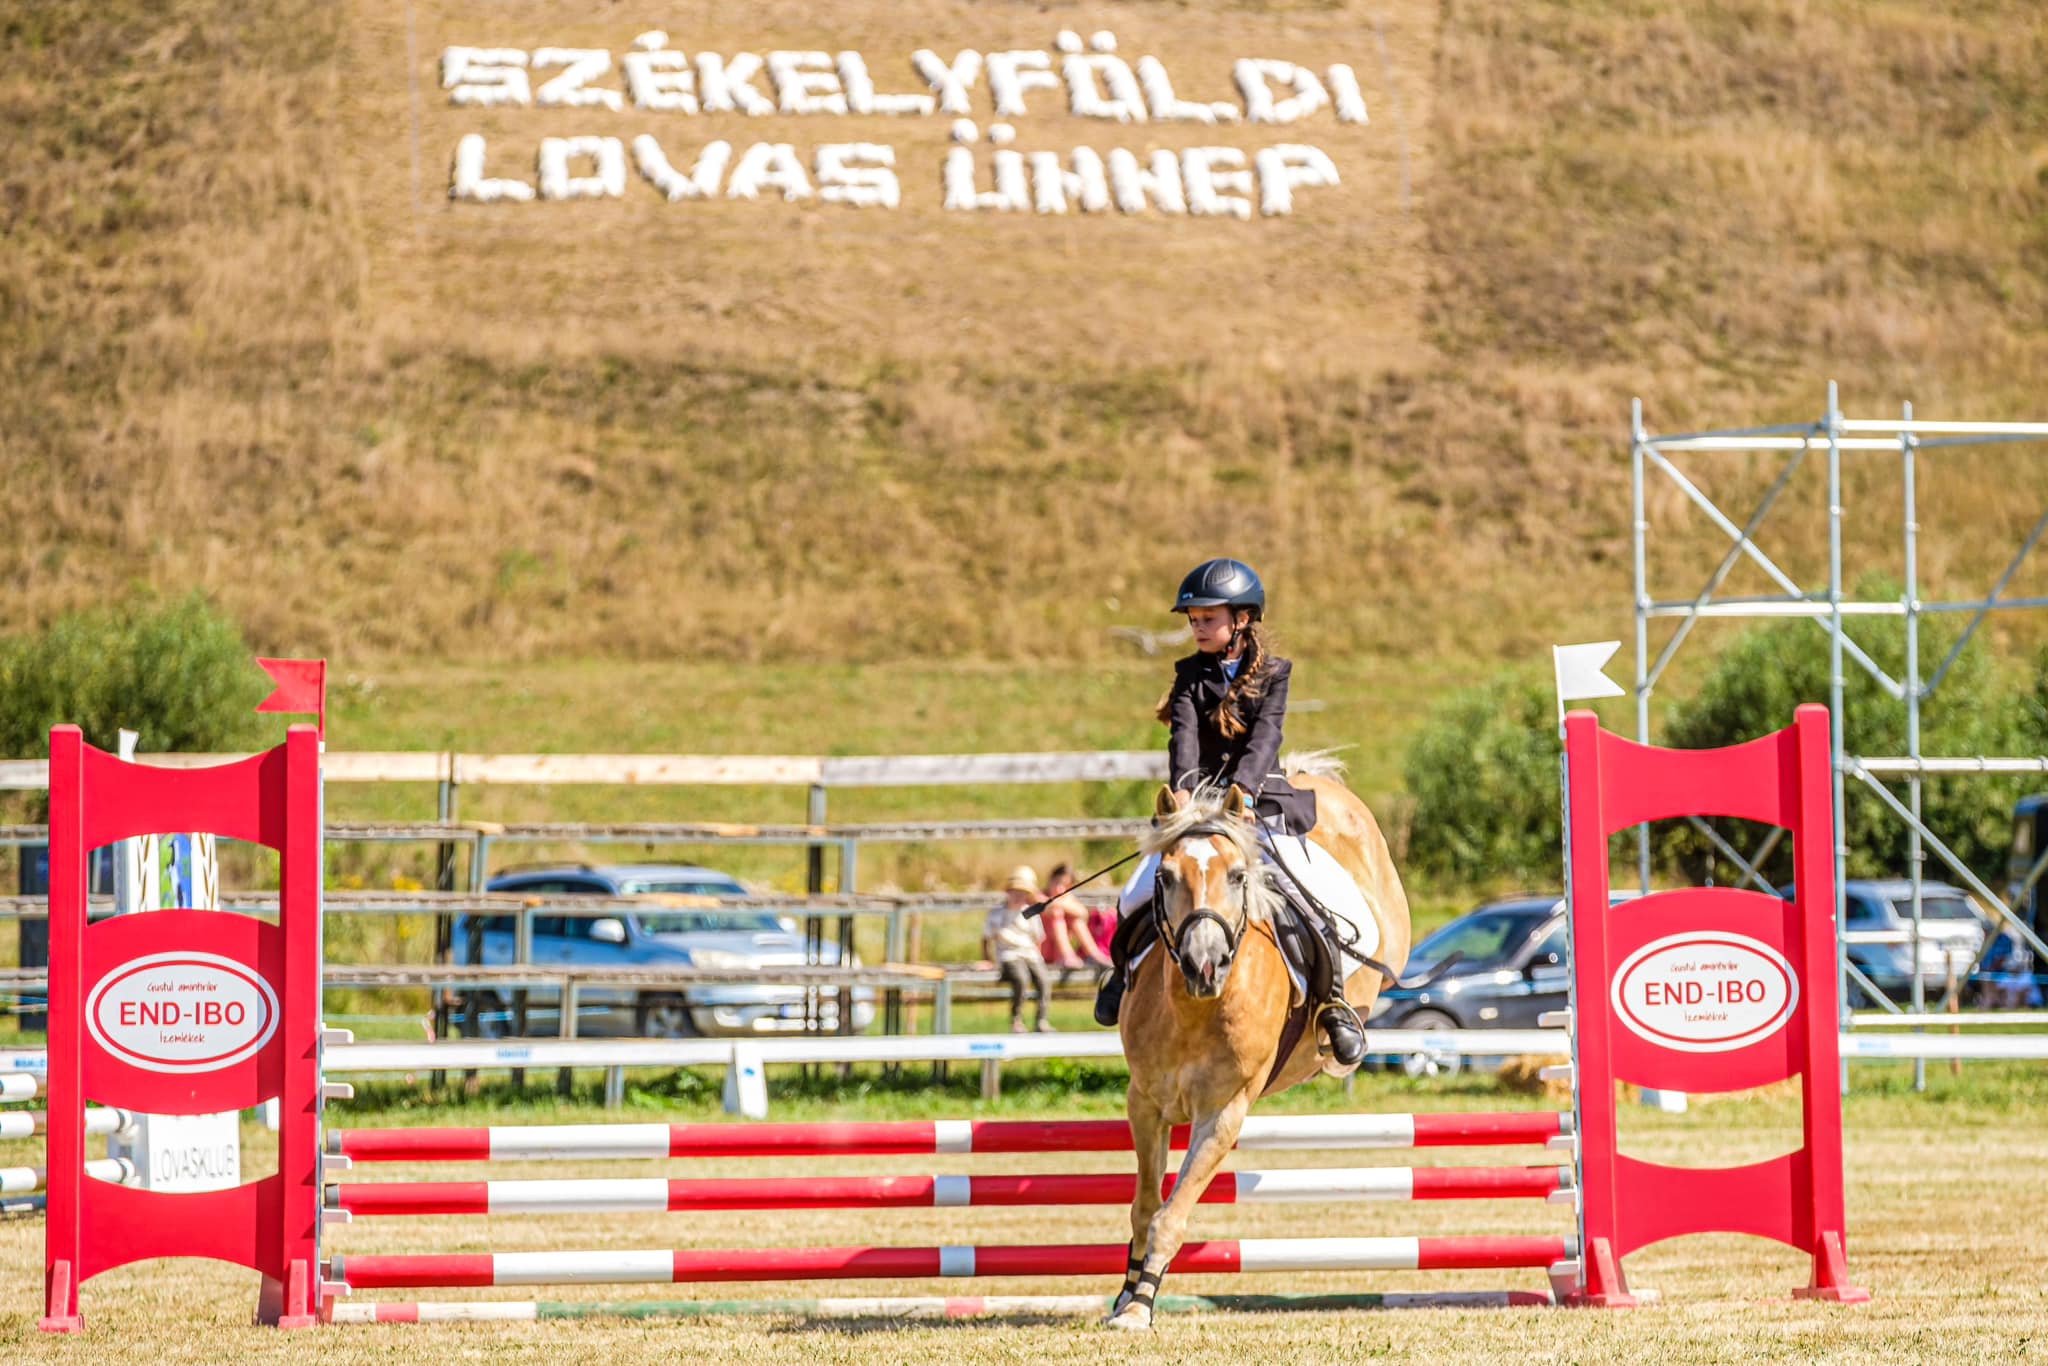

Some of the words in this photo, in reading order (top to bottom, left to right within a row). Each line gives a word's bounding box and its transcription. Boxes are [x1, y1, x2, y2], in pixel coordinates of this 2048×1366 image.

[443, 30, 1368, 125] SZÉKELYFÖLDI
[450, 133, 901, 208] LOVAS
[943, 118, 1340, 220] ÜNNEP
[1645, 979, 1766, 1006] END-IBO
[119, 1001, 245, 1026] END-IBO
[152, 1144, 234, 1182] LOVASKLUB
